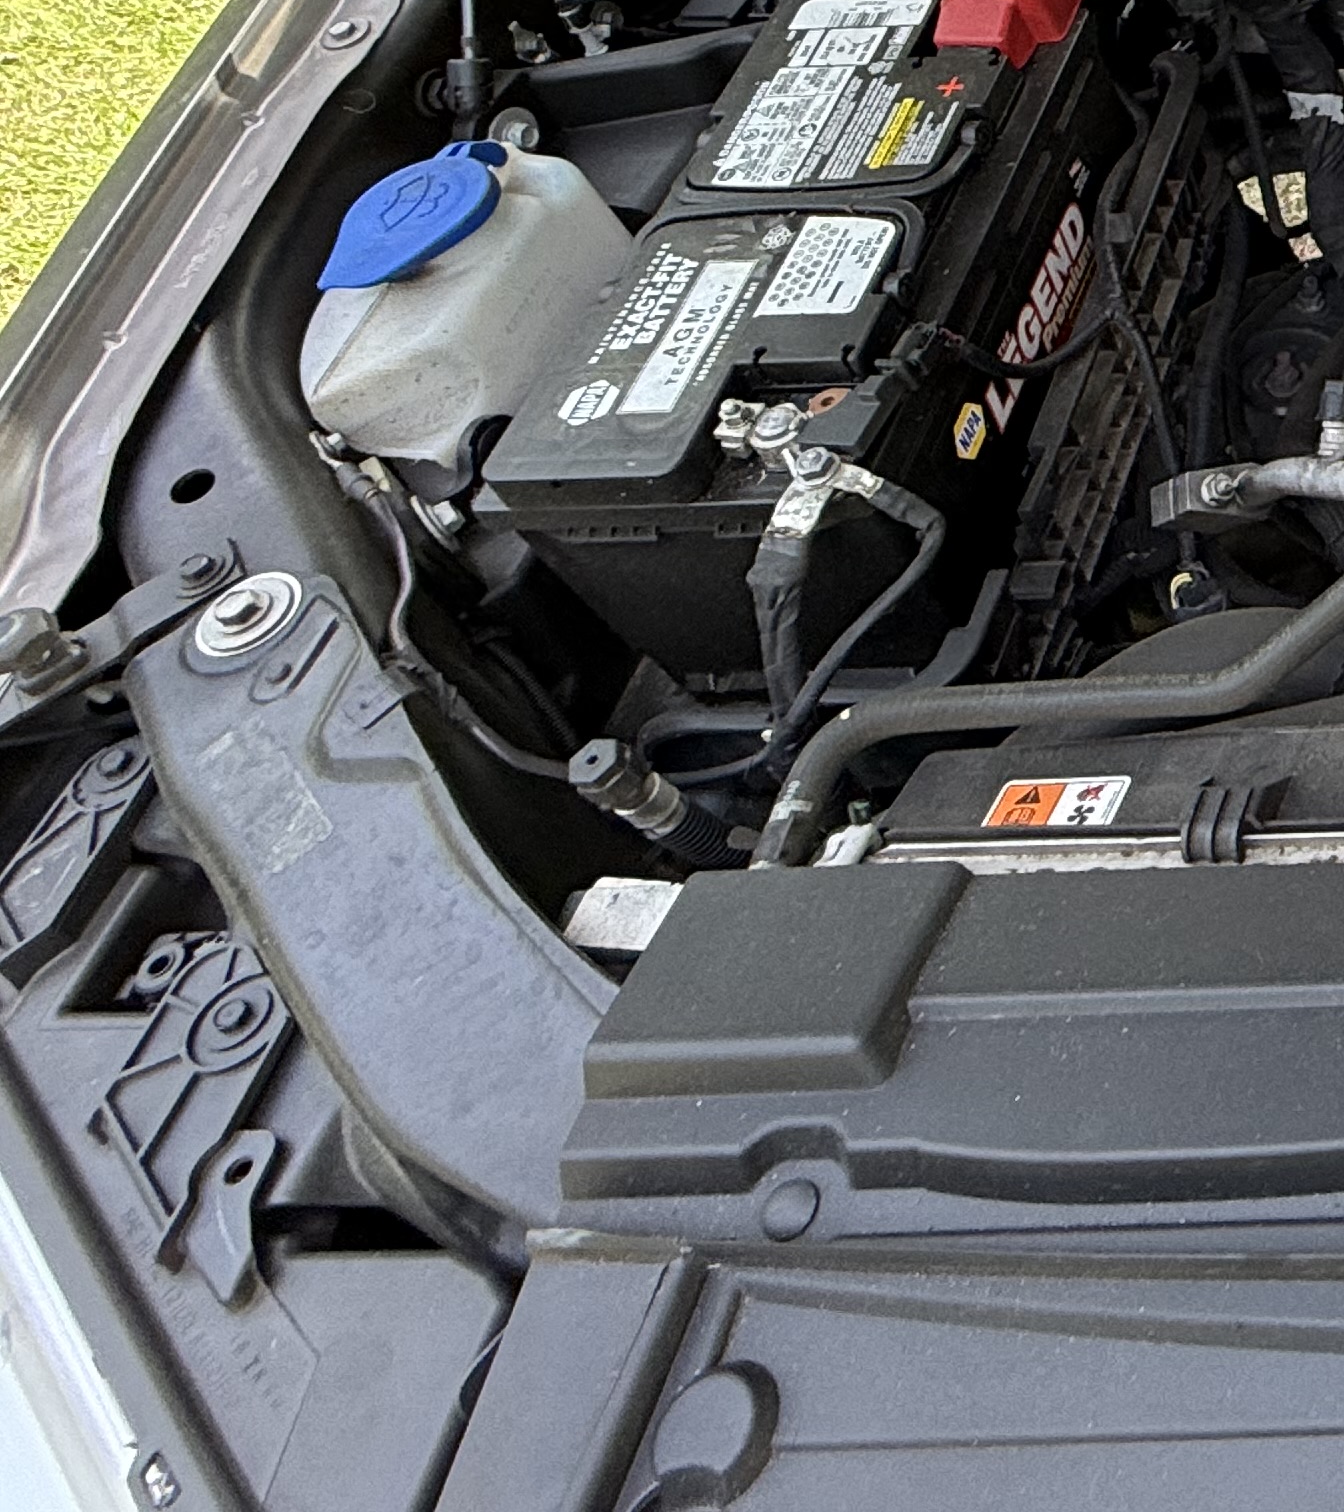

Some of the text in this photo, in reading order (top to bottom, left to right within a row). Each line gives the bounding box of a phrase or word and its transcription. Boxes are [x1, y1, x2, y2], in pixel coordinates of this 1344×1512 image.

[609, 253, 682, 350] EXACT-FIT
[632, 257, 699, 344] BATTERY
[663, 308, 706, 358] AGM
[664, 283, 734, 385] TECHNOLOGY
[568, 384, 608, 421] NAPA
[958, 410, 982, 453] NAPA
